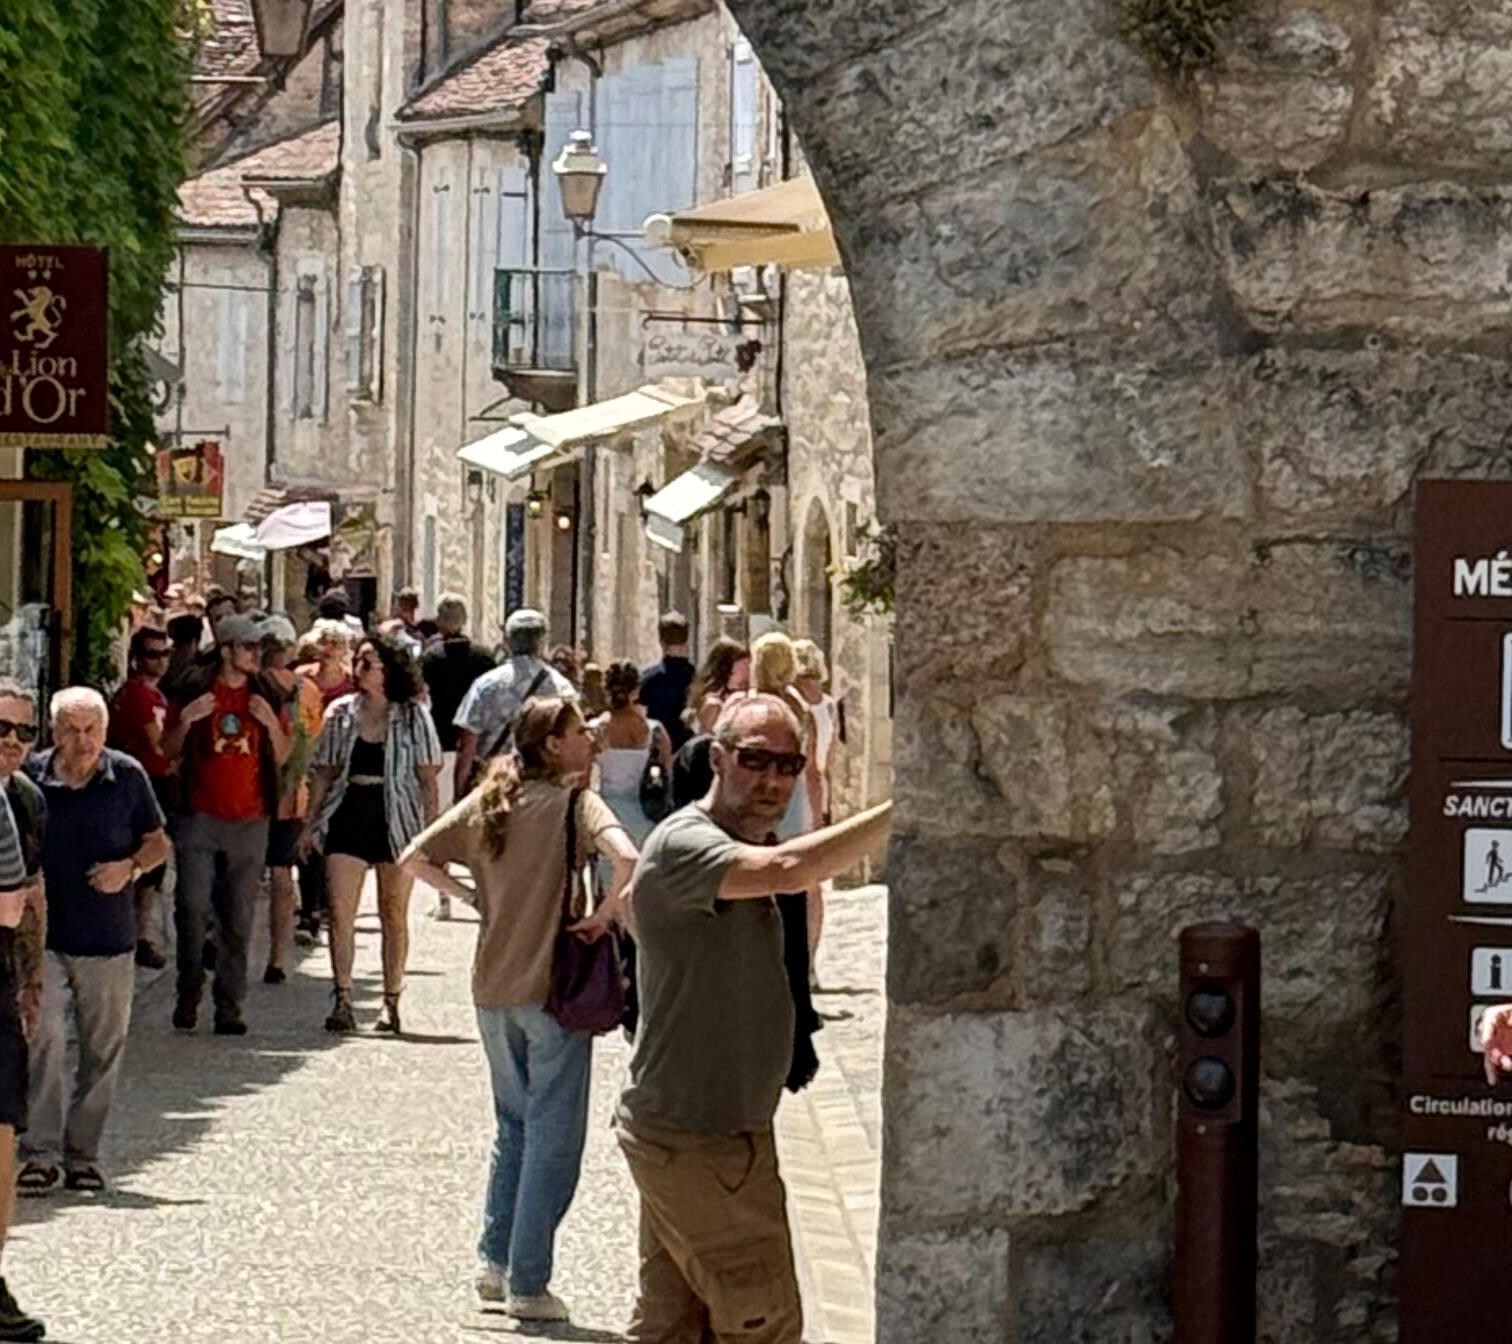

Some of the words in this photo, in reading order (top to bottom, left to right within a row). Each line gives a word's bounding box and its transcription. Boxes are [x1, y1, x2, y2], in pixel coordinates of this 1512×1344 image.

[14, 254, 65, 269] HÔTEL
[11, 349, 78, 377] Lion
[1453, 550, 1512, 596] MÉ
